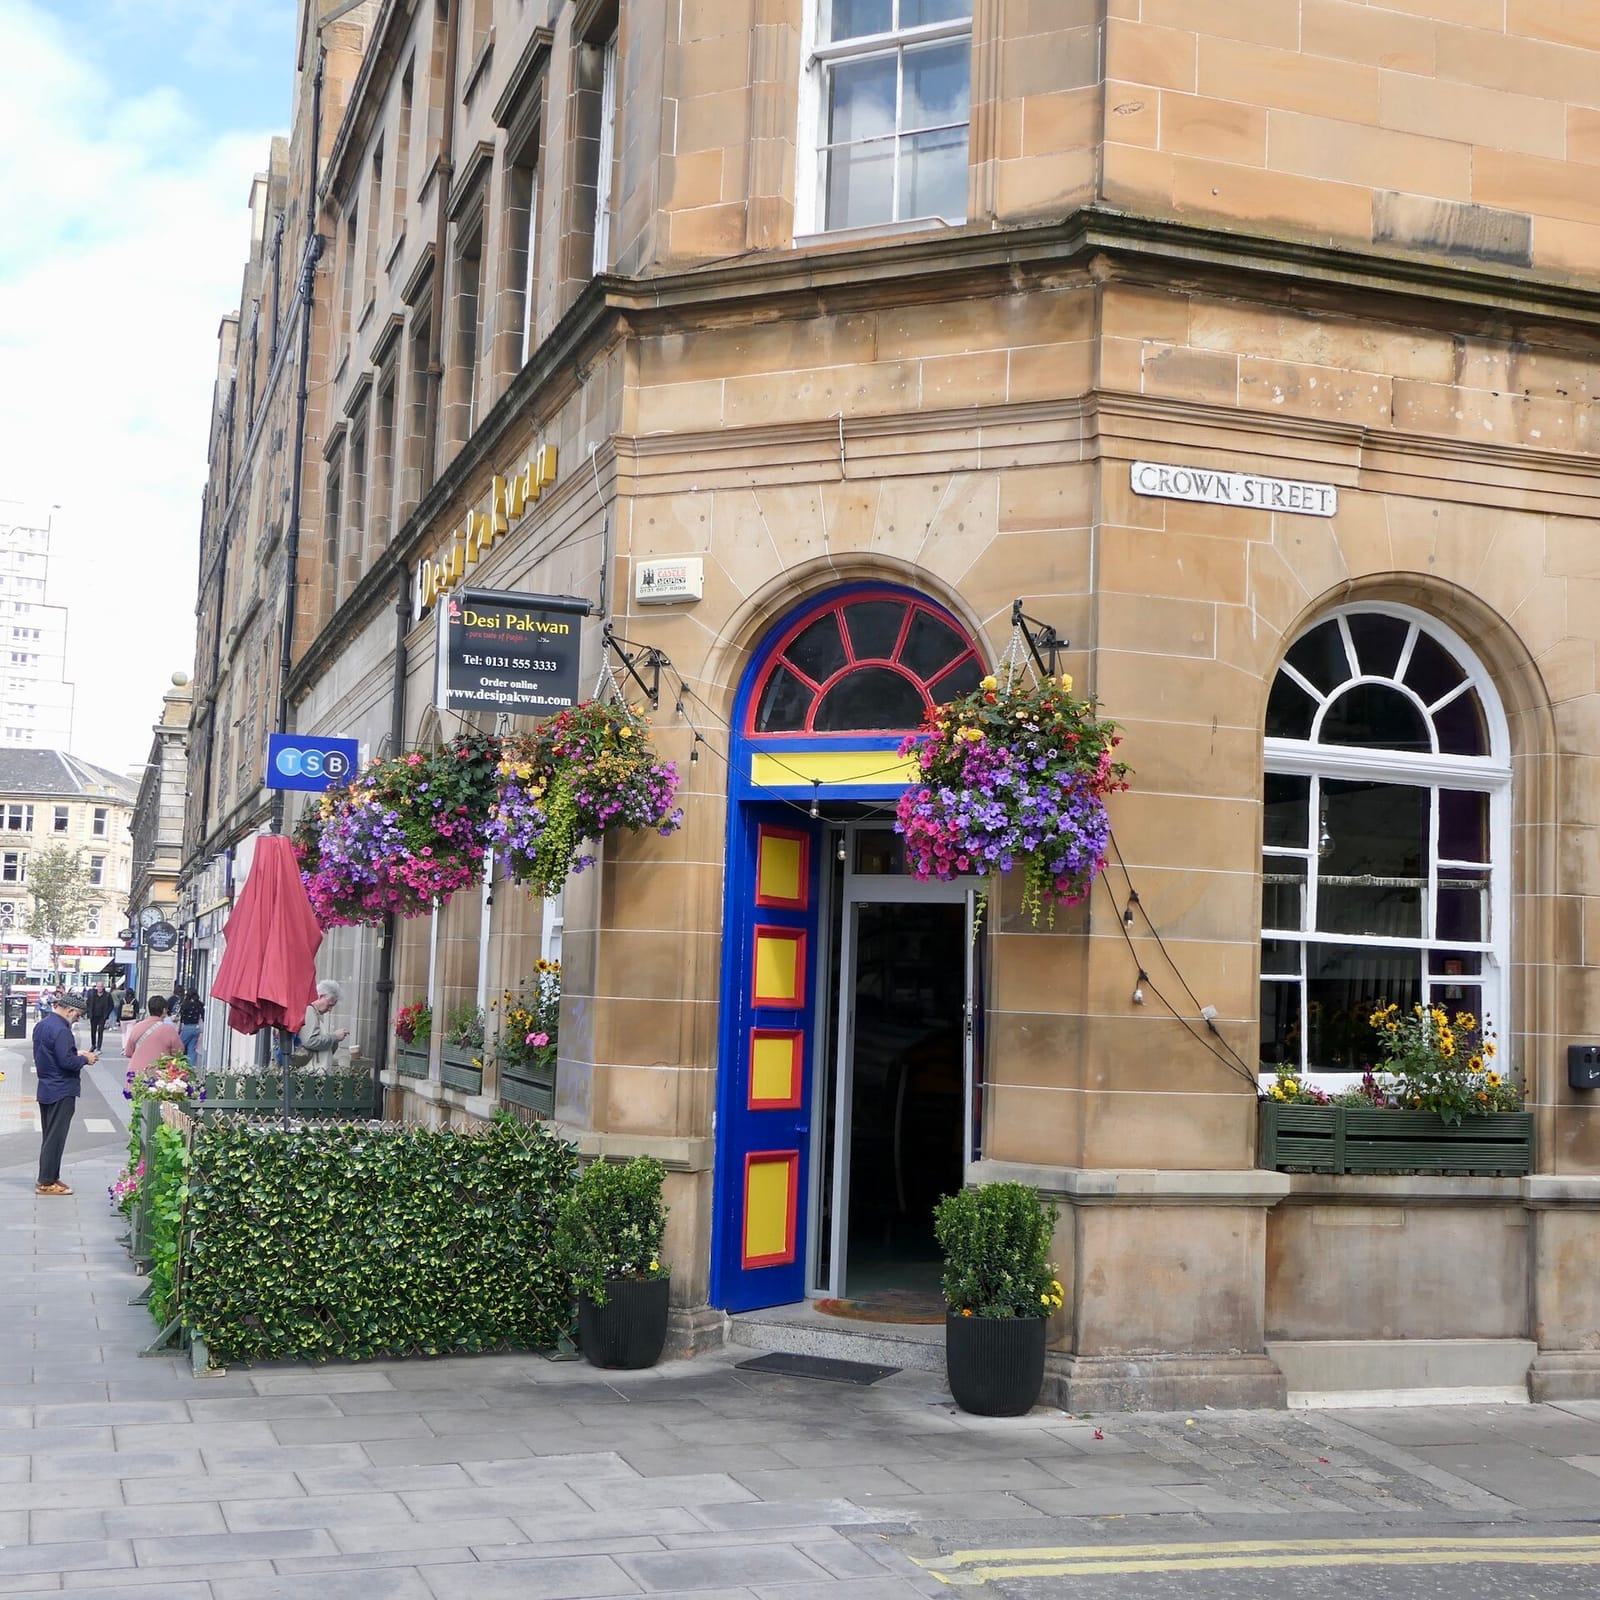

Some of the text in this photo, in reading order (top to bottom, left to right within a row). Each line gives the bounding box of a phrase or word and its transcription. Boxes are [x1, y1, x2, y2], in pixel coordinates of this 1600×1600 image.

[1139, 467, 1331, 512] CROWN STREET
[463, 610, 569, 634] Desi Pakwan
[463, 654, 557, 671] Tel: 0131 555 3333
[480, 677, 538, 690] Order online
[446, 688, 571, 706] www.desipakwan.com
[285, 754, 342, 772] TSB
